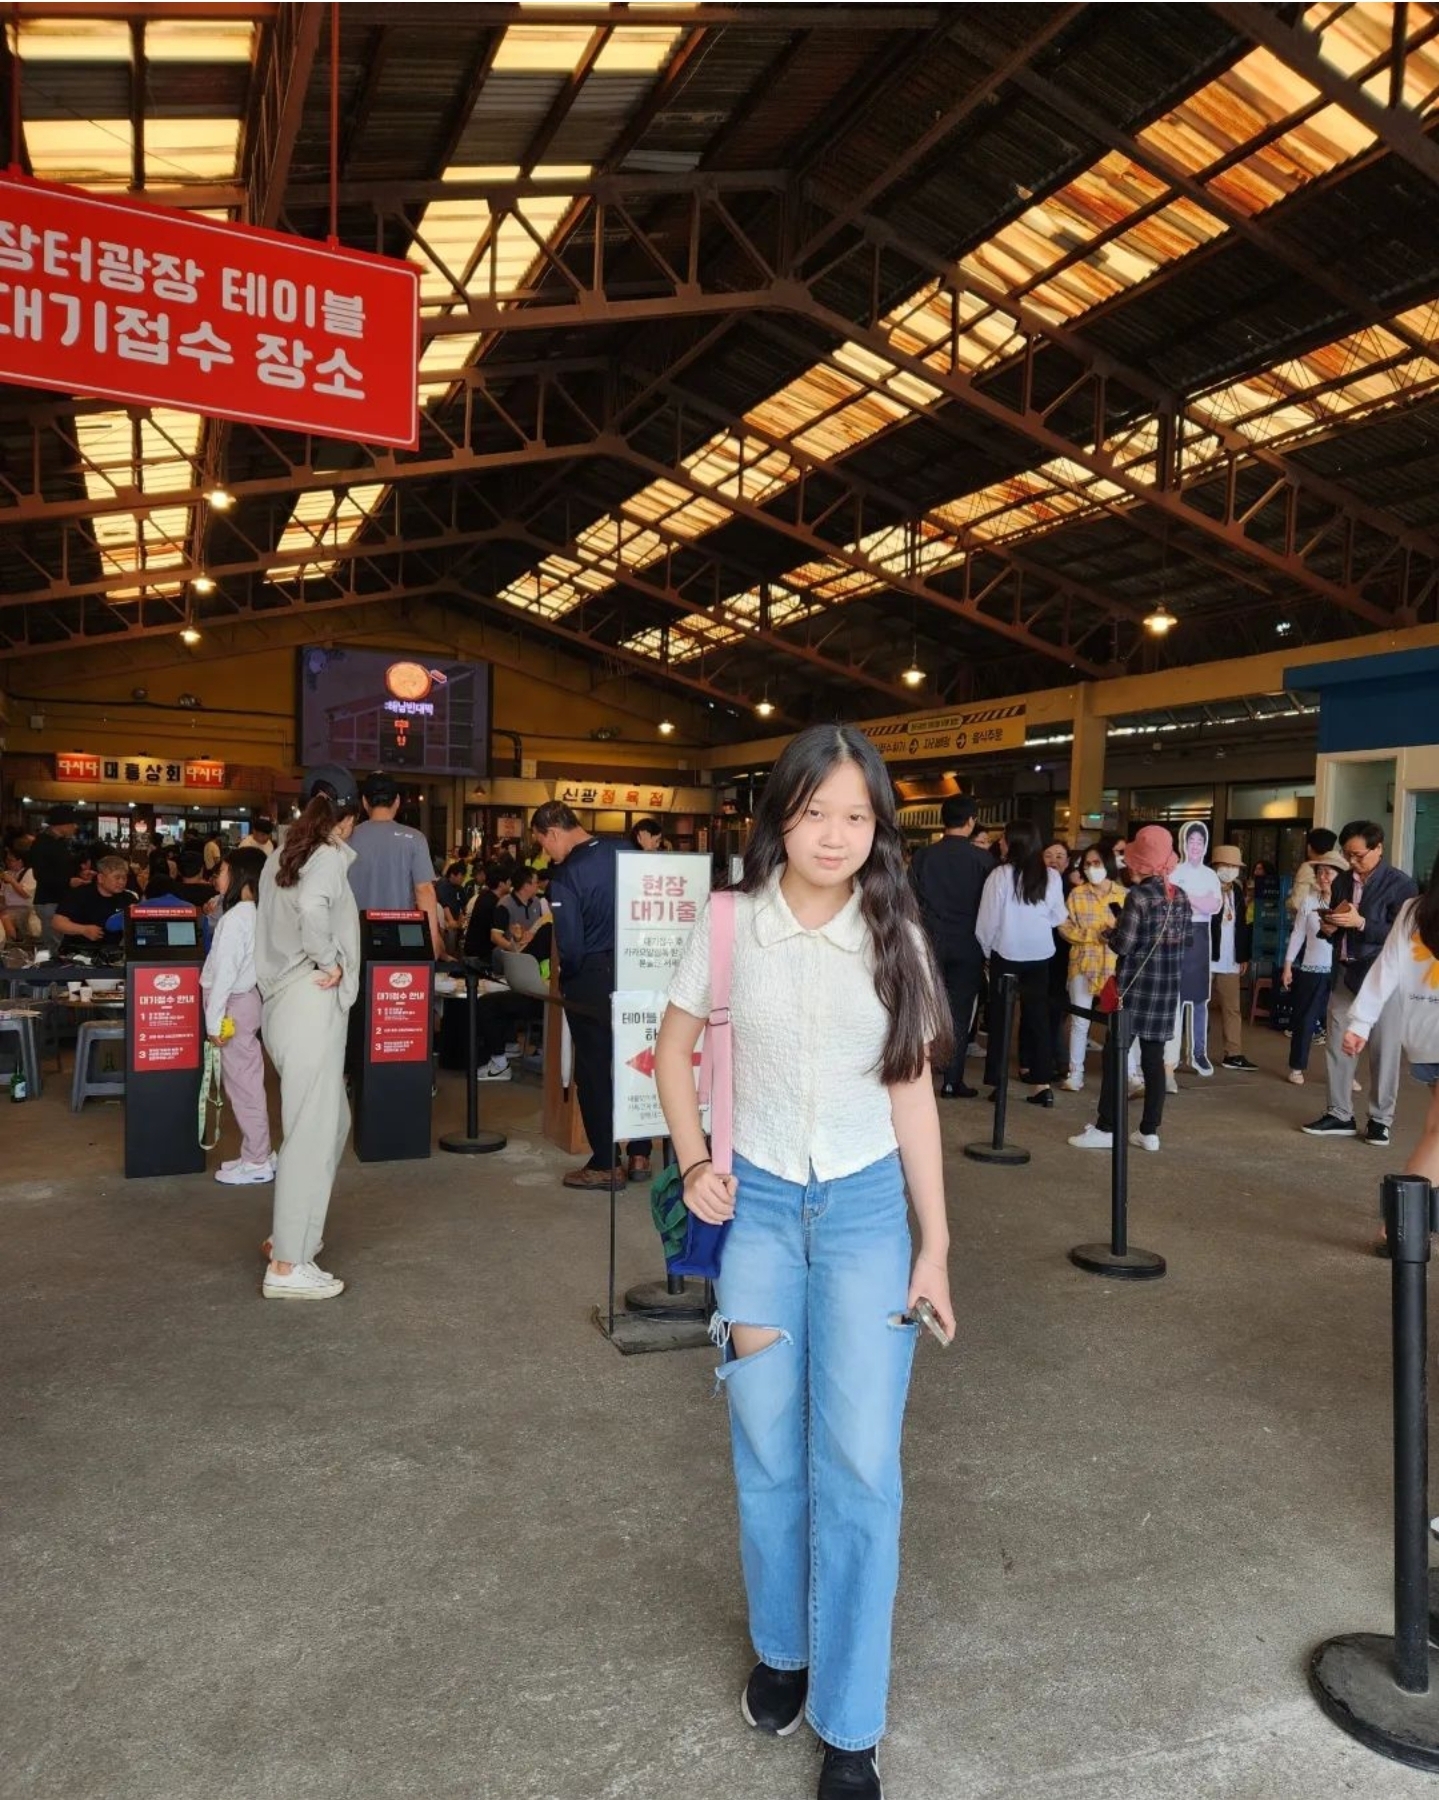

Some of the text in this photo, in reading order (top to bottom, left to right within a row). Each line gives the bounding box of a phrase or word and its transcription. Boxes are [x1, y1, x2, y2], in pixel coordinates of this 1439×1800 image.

[0, 221, 367, 339] 장터광장 테이블
[0, 284, 366, 400] 대기접수 장소
[972, 728, 1003, 744] 음식주문
[58, 760, 99, 777] 다시다
[186, 766, 224, 783] 다시다
[642, 875, 687, 897] 현장
[631, 900, 697, 923] 대기줄
[140, 1012, 146, 1021] 1
[622, 1012, 657, 1024] 테이블
[138, 1033, 147, 1042] 2
[375, 1027, 382, 1035] 2
[138, 1050, 147, 1059] 3
[375, 1043, 382, 1051] 3
